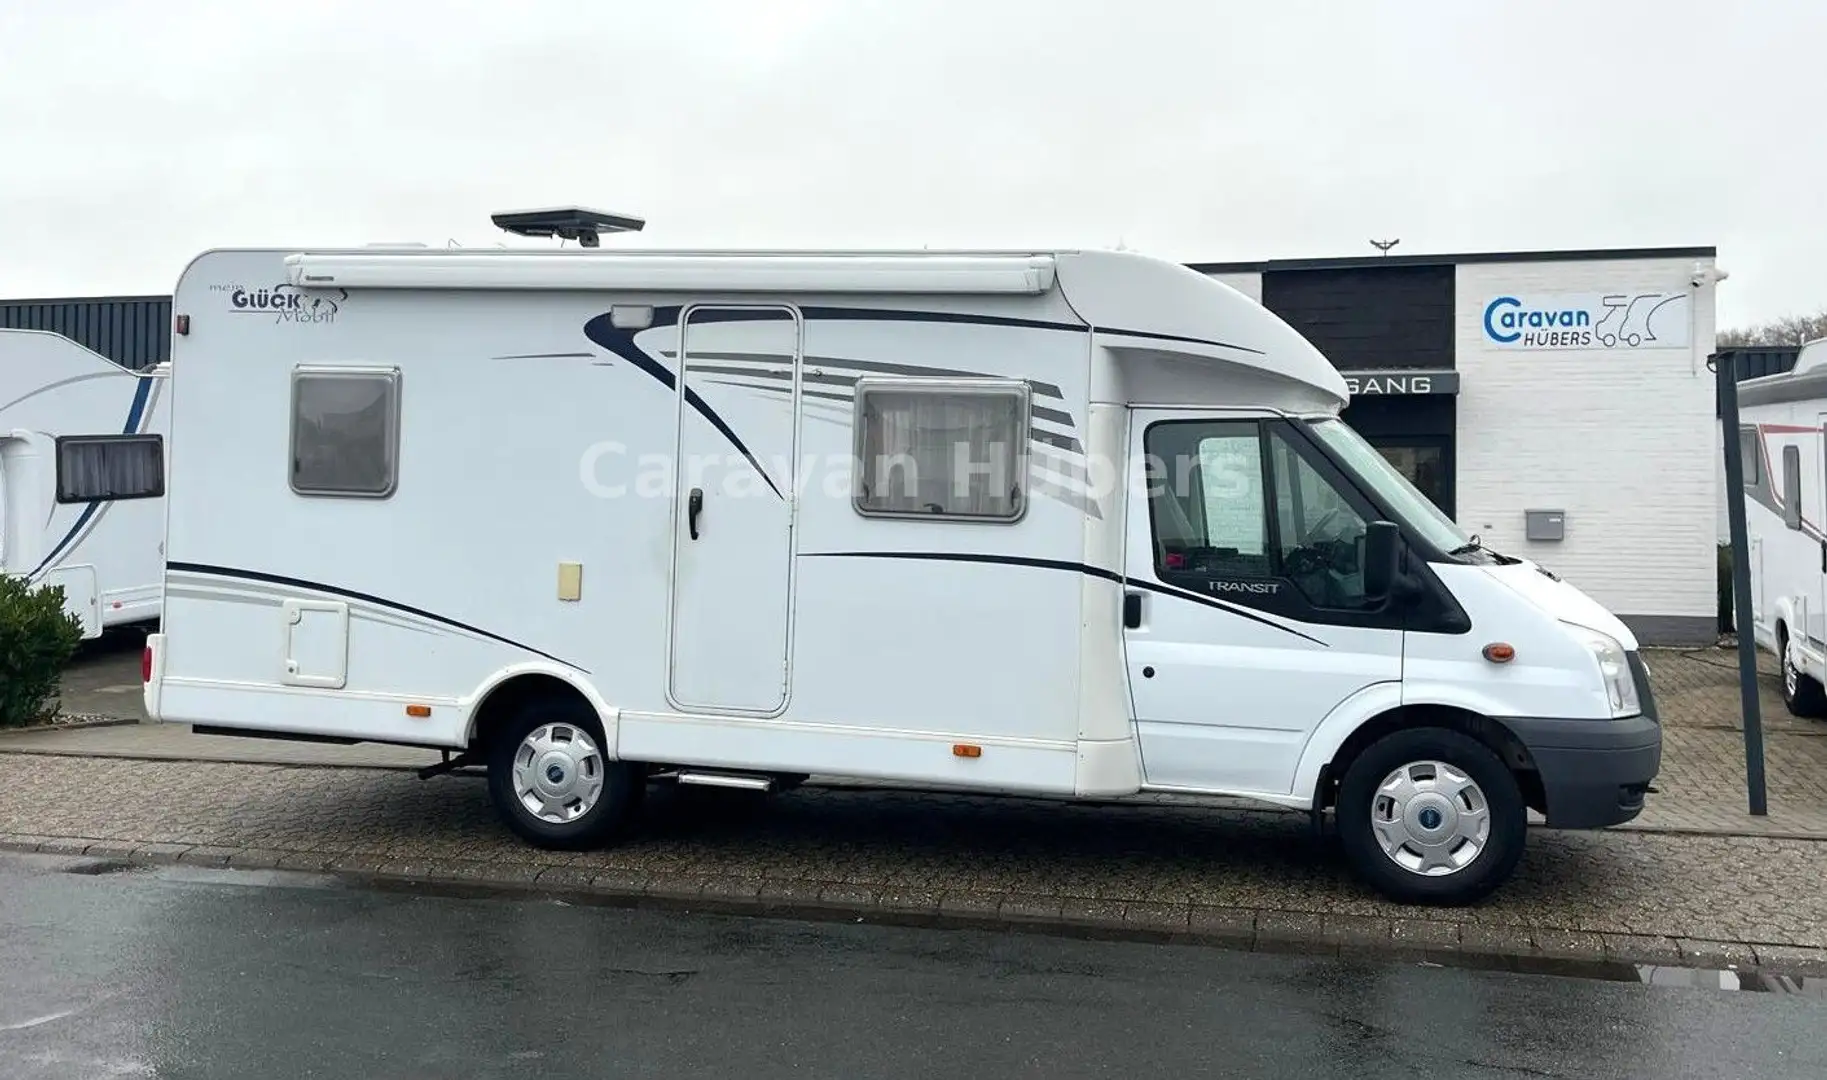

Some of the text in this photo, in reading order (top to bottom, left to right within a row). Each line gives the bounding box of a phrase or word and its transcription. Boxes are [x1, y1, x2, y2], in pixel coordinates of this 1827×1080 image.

[1484, 296, 1590, 343] Caravan
[1523, 328, 1592, 346] HÜBERS
[1208, 580, 1279, 595] TRANSIT
